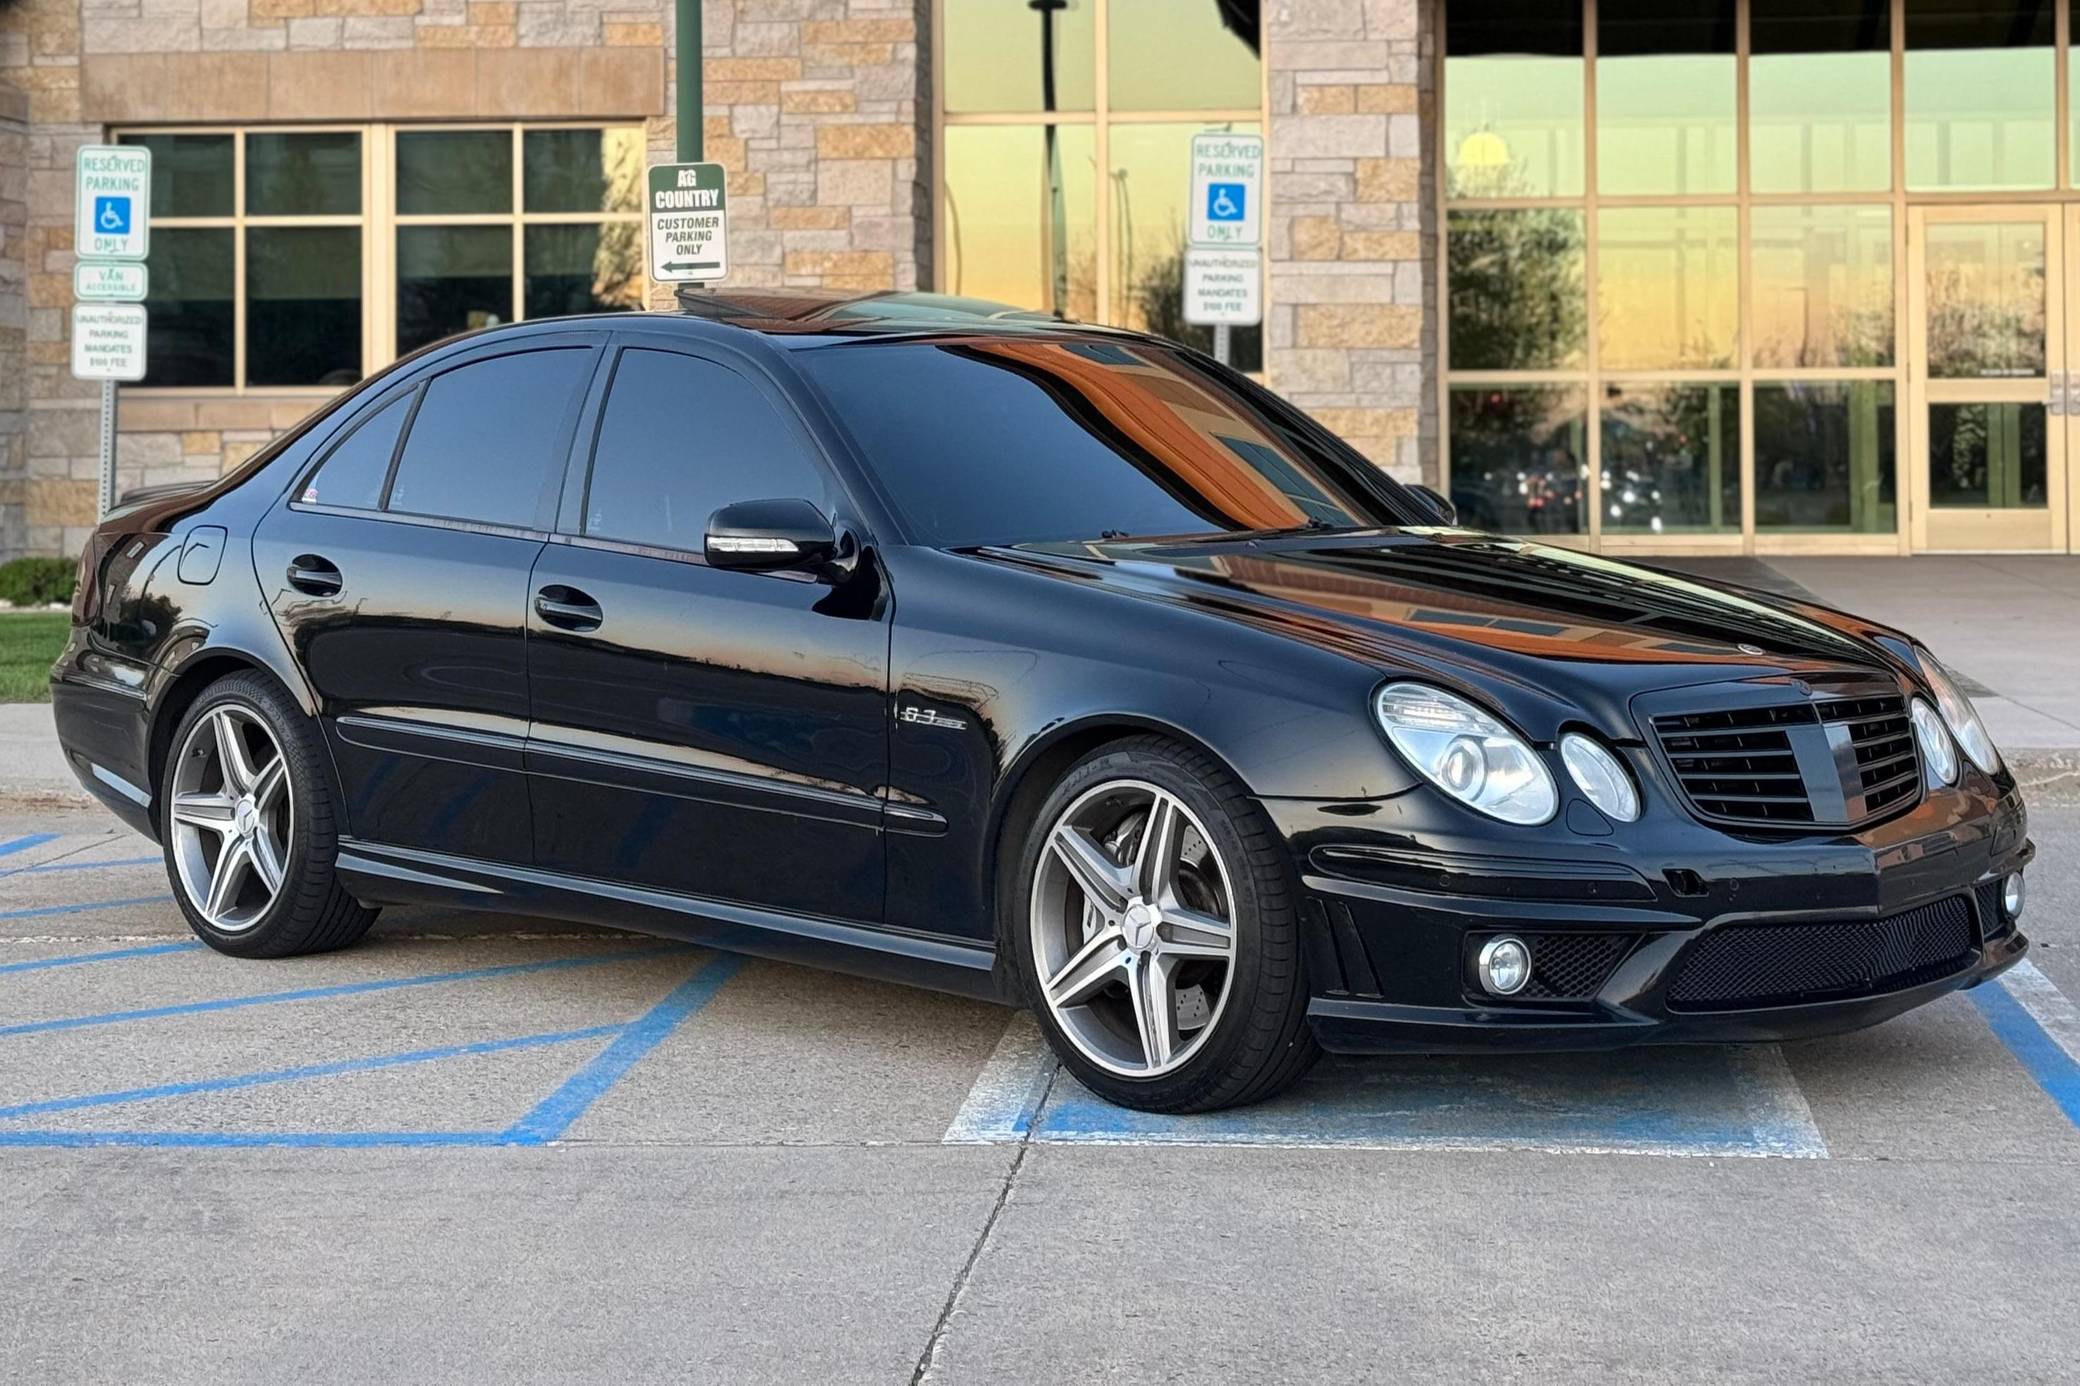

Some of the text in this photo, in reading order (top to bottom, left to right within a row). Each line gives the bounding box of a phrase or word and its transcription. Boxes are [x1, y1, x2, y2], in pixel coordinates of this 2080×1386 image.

[1196, 144, 1260, 159] RESERVED
[83, 157, 145, 173] RESERVED
[1199, 163, 1255, 178] PARKING
[86, 176, 139, 192] PARKING
[677, 169, 697, 188] AG
[655, 188, 719, 209] COUNTRY
[657, 216, 719, 230] CUSTOMER
[665, 230, 712, 243] PARKING
[1207, 225, 1243, 239] ONLY
[95, 238, 129, 251] ONLY
[676, 244, 702, 256] ONLY
[99, 269, 124, 281] VAN
[1202, 273, 1244, 283] PARKING
[86, 282, 136, 292] ACCESSIBLE
[1197, 288, 1248, 298] MANDATES
[89, 329, 129, 339] PARKING
[84, 344, 132, 354] MANDATES
